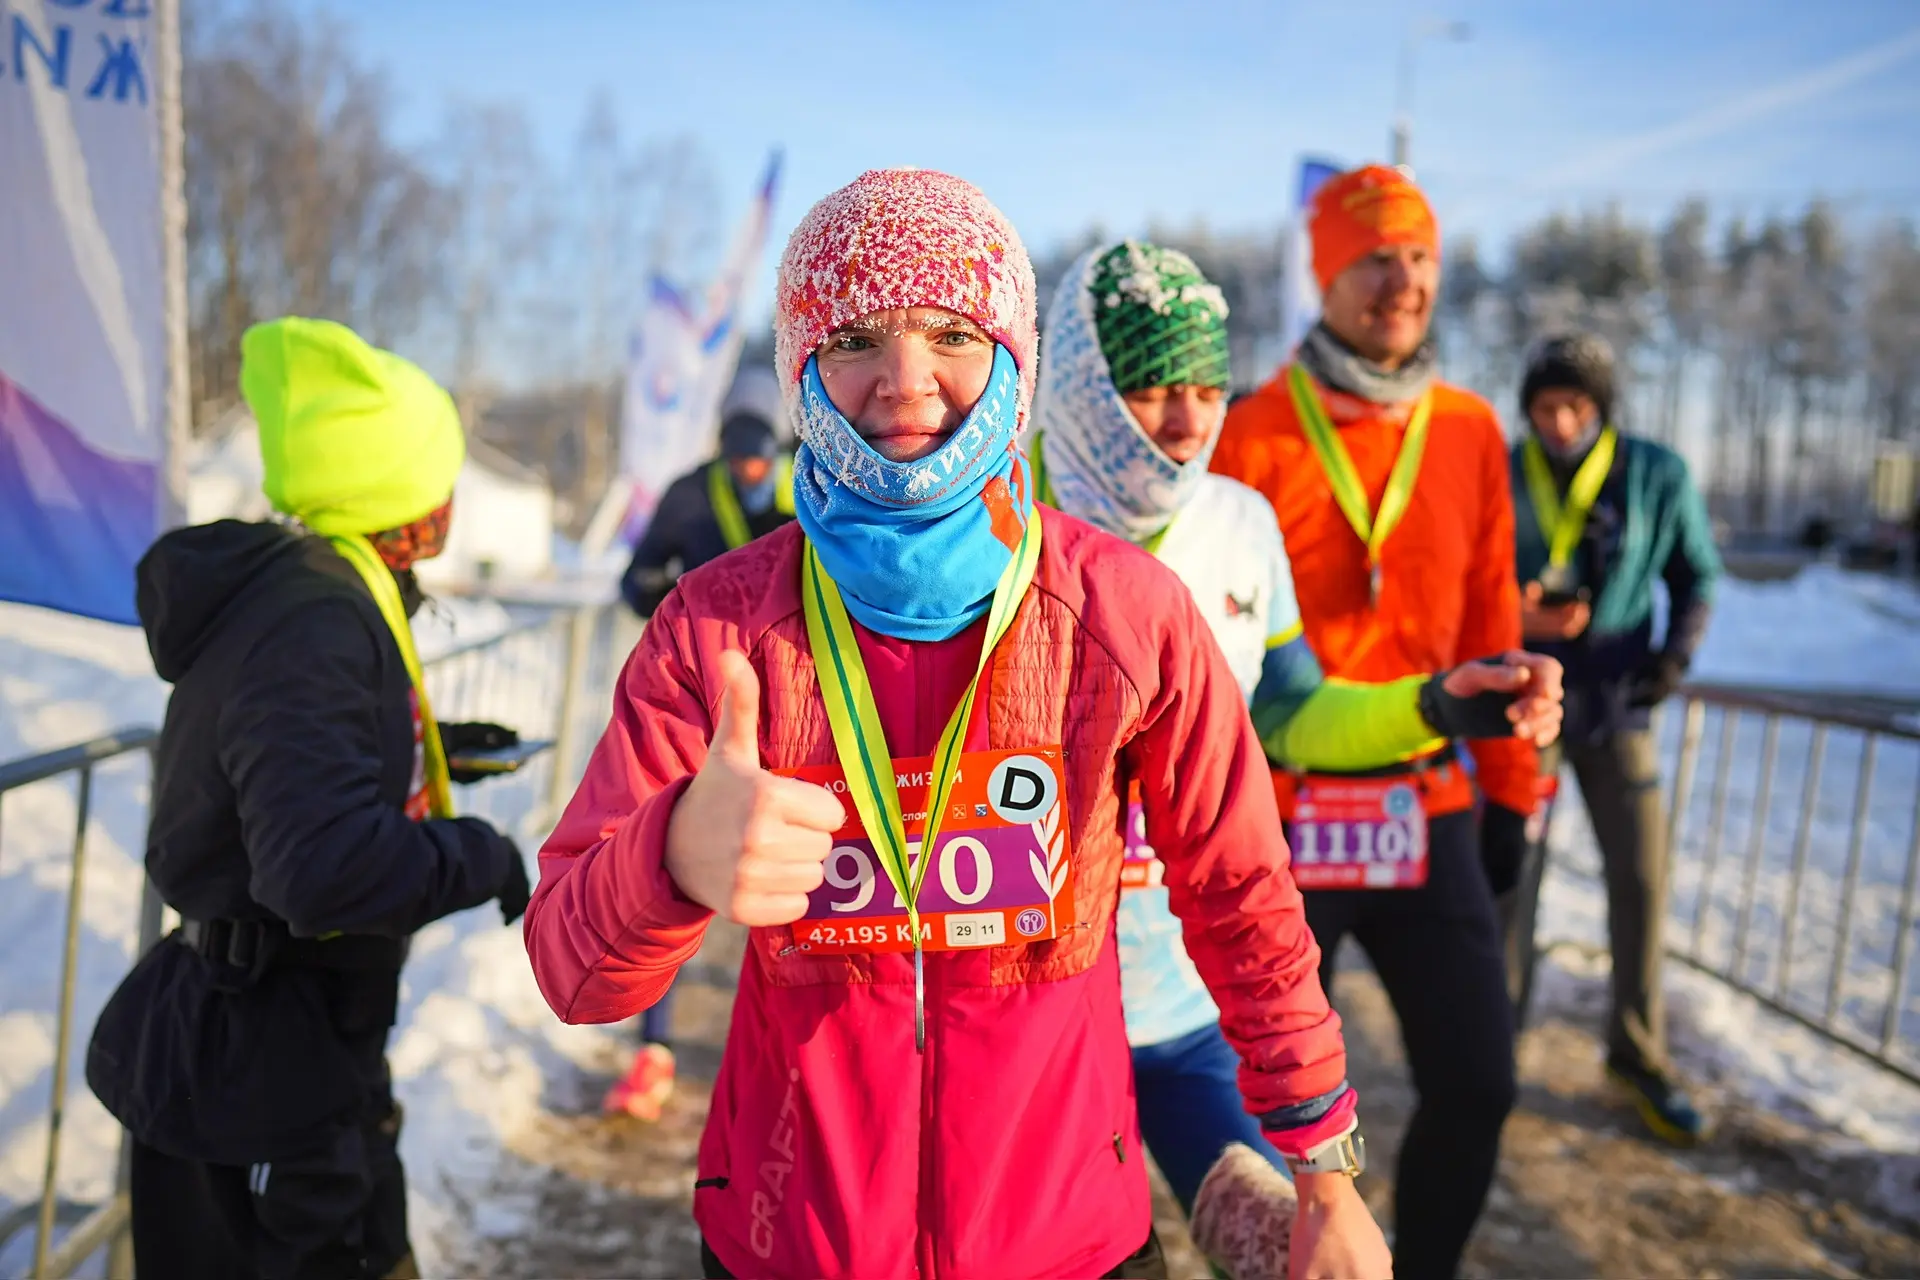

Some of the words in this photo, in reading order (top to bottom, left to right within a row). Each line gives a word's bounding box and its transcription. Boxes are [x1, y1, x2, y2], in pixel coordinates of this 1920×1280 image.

[905, 369, 1011, 492] ЖИЗНИ
[896, 769, 963, 788] ЖИЗИ
[999, 766, 1046, 811] D
[902, 811, 928, 822] СПОР
[1295, 821, 1408, 864] 1110
[809, 925, 888, 946] 42,195
[955, 925, 972, 936] 29
[981, 924, 994, 935] 11
[750, 1082, 800, 1259] CRAFT
